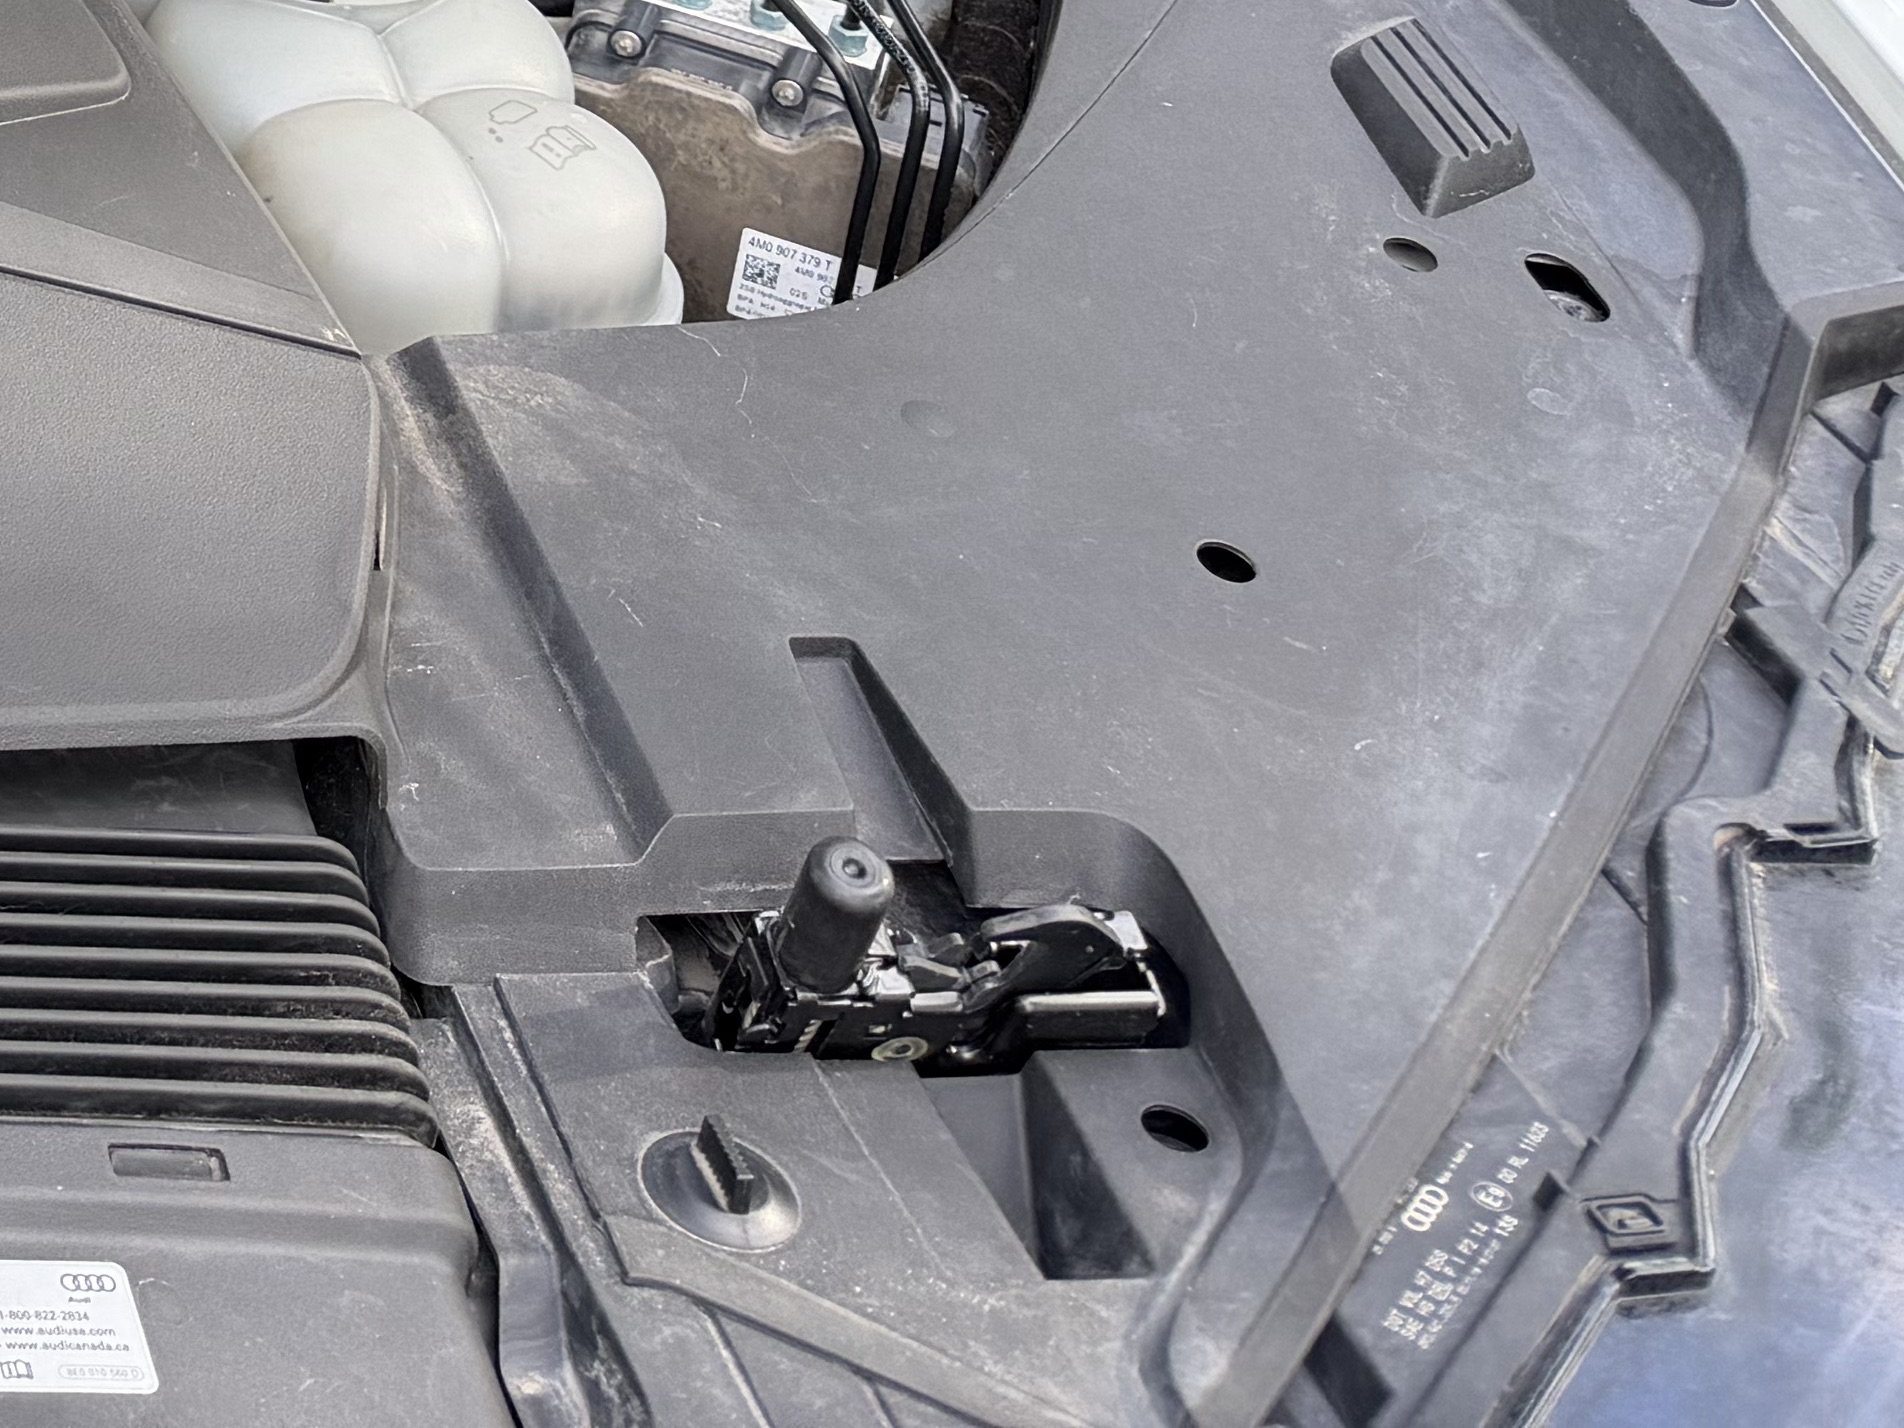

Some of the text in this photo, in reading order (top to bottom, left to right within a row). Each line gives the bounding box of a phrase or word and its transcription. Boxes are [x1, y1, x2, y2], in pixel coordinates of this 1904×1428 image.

[748, 236, 833, 271] 4M0 907 379 T
[1, 1326, 116, 1336] www.audiusa.com
